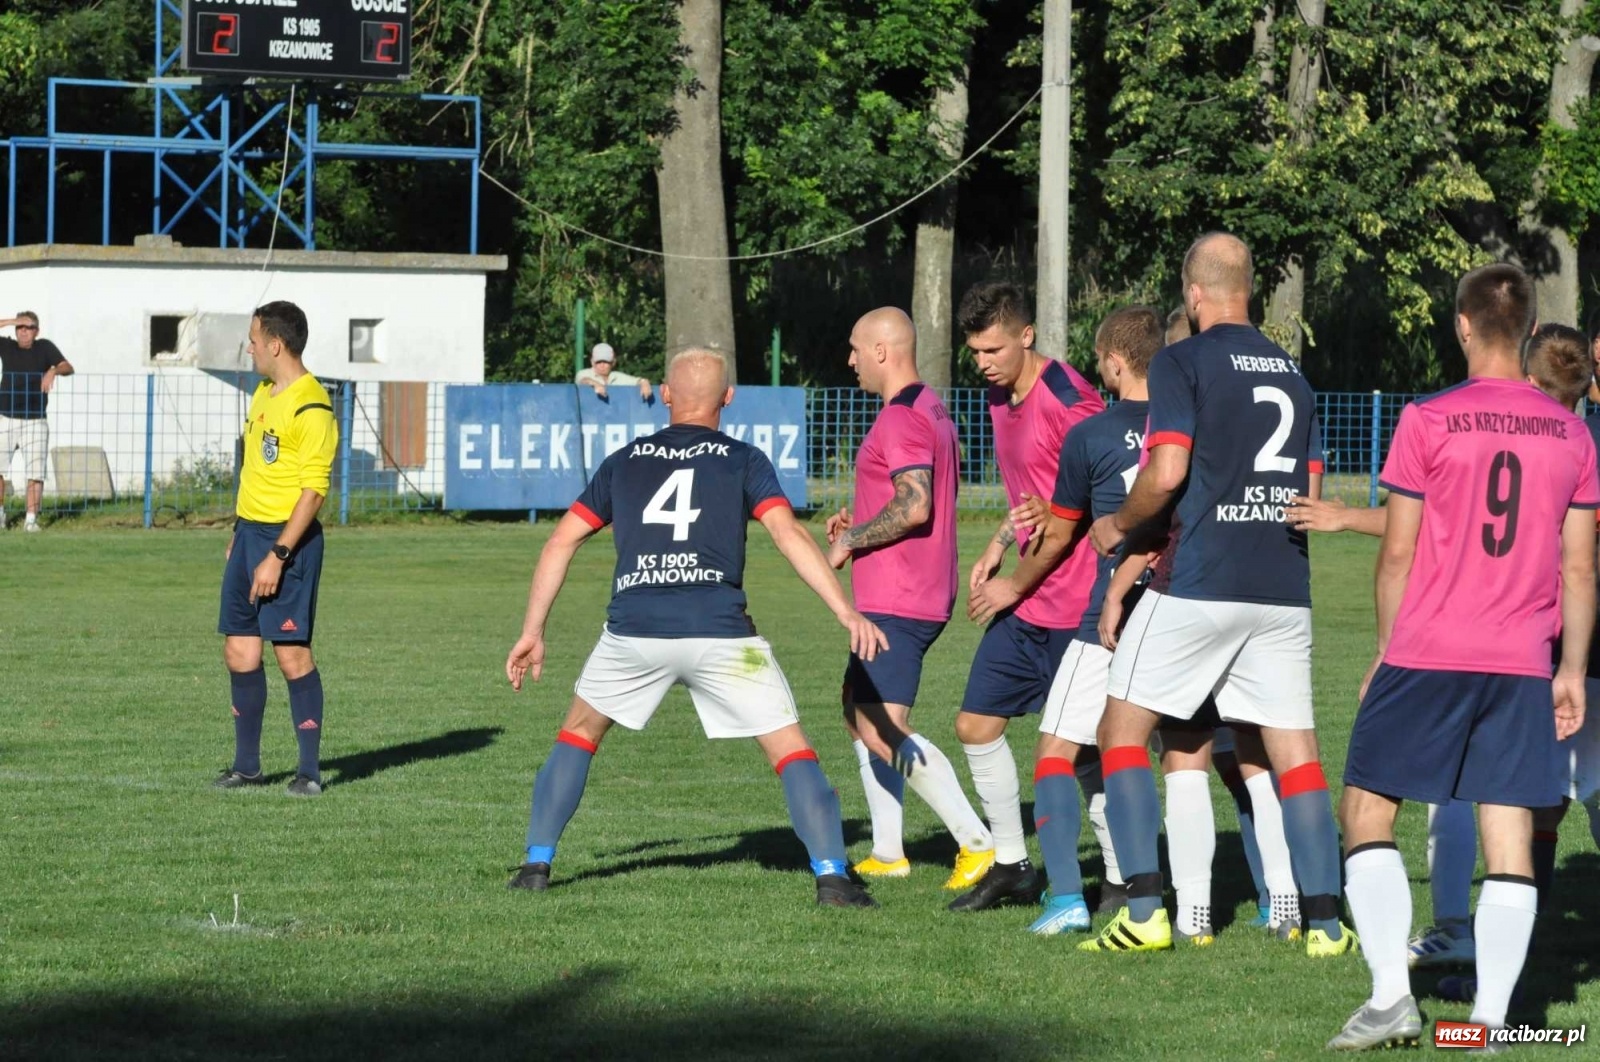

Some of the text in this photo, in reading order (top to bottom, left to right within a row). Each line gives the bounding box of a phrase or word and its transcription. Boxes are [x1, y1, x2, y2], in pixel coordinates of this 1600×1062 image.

[213, 15, 236, 54] 2
[283, 17, 320, 37] KS 1905
[269, 40, 334, 61] KRZANOWICE
[375, 24, 398, 62] 2
[1229, 353, 1290, 373] HERBER
[1252, 385, 1297, 473] 2
[1474, 411, 1568, 440] KRZYŻANOWICE
[629, 442, 730, 461] ADAMCZYK
[642, 468, 702, 541] 4
[1243, 486, 1265, 503] KS
[1481, 450, 1523, 558] 9
[637, 552, 698, 570] KS 1905
[616, 567, 724, 593] KRZANOWICE
